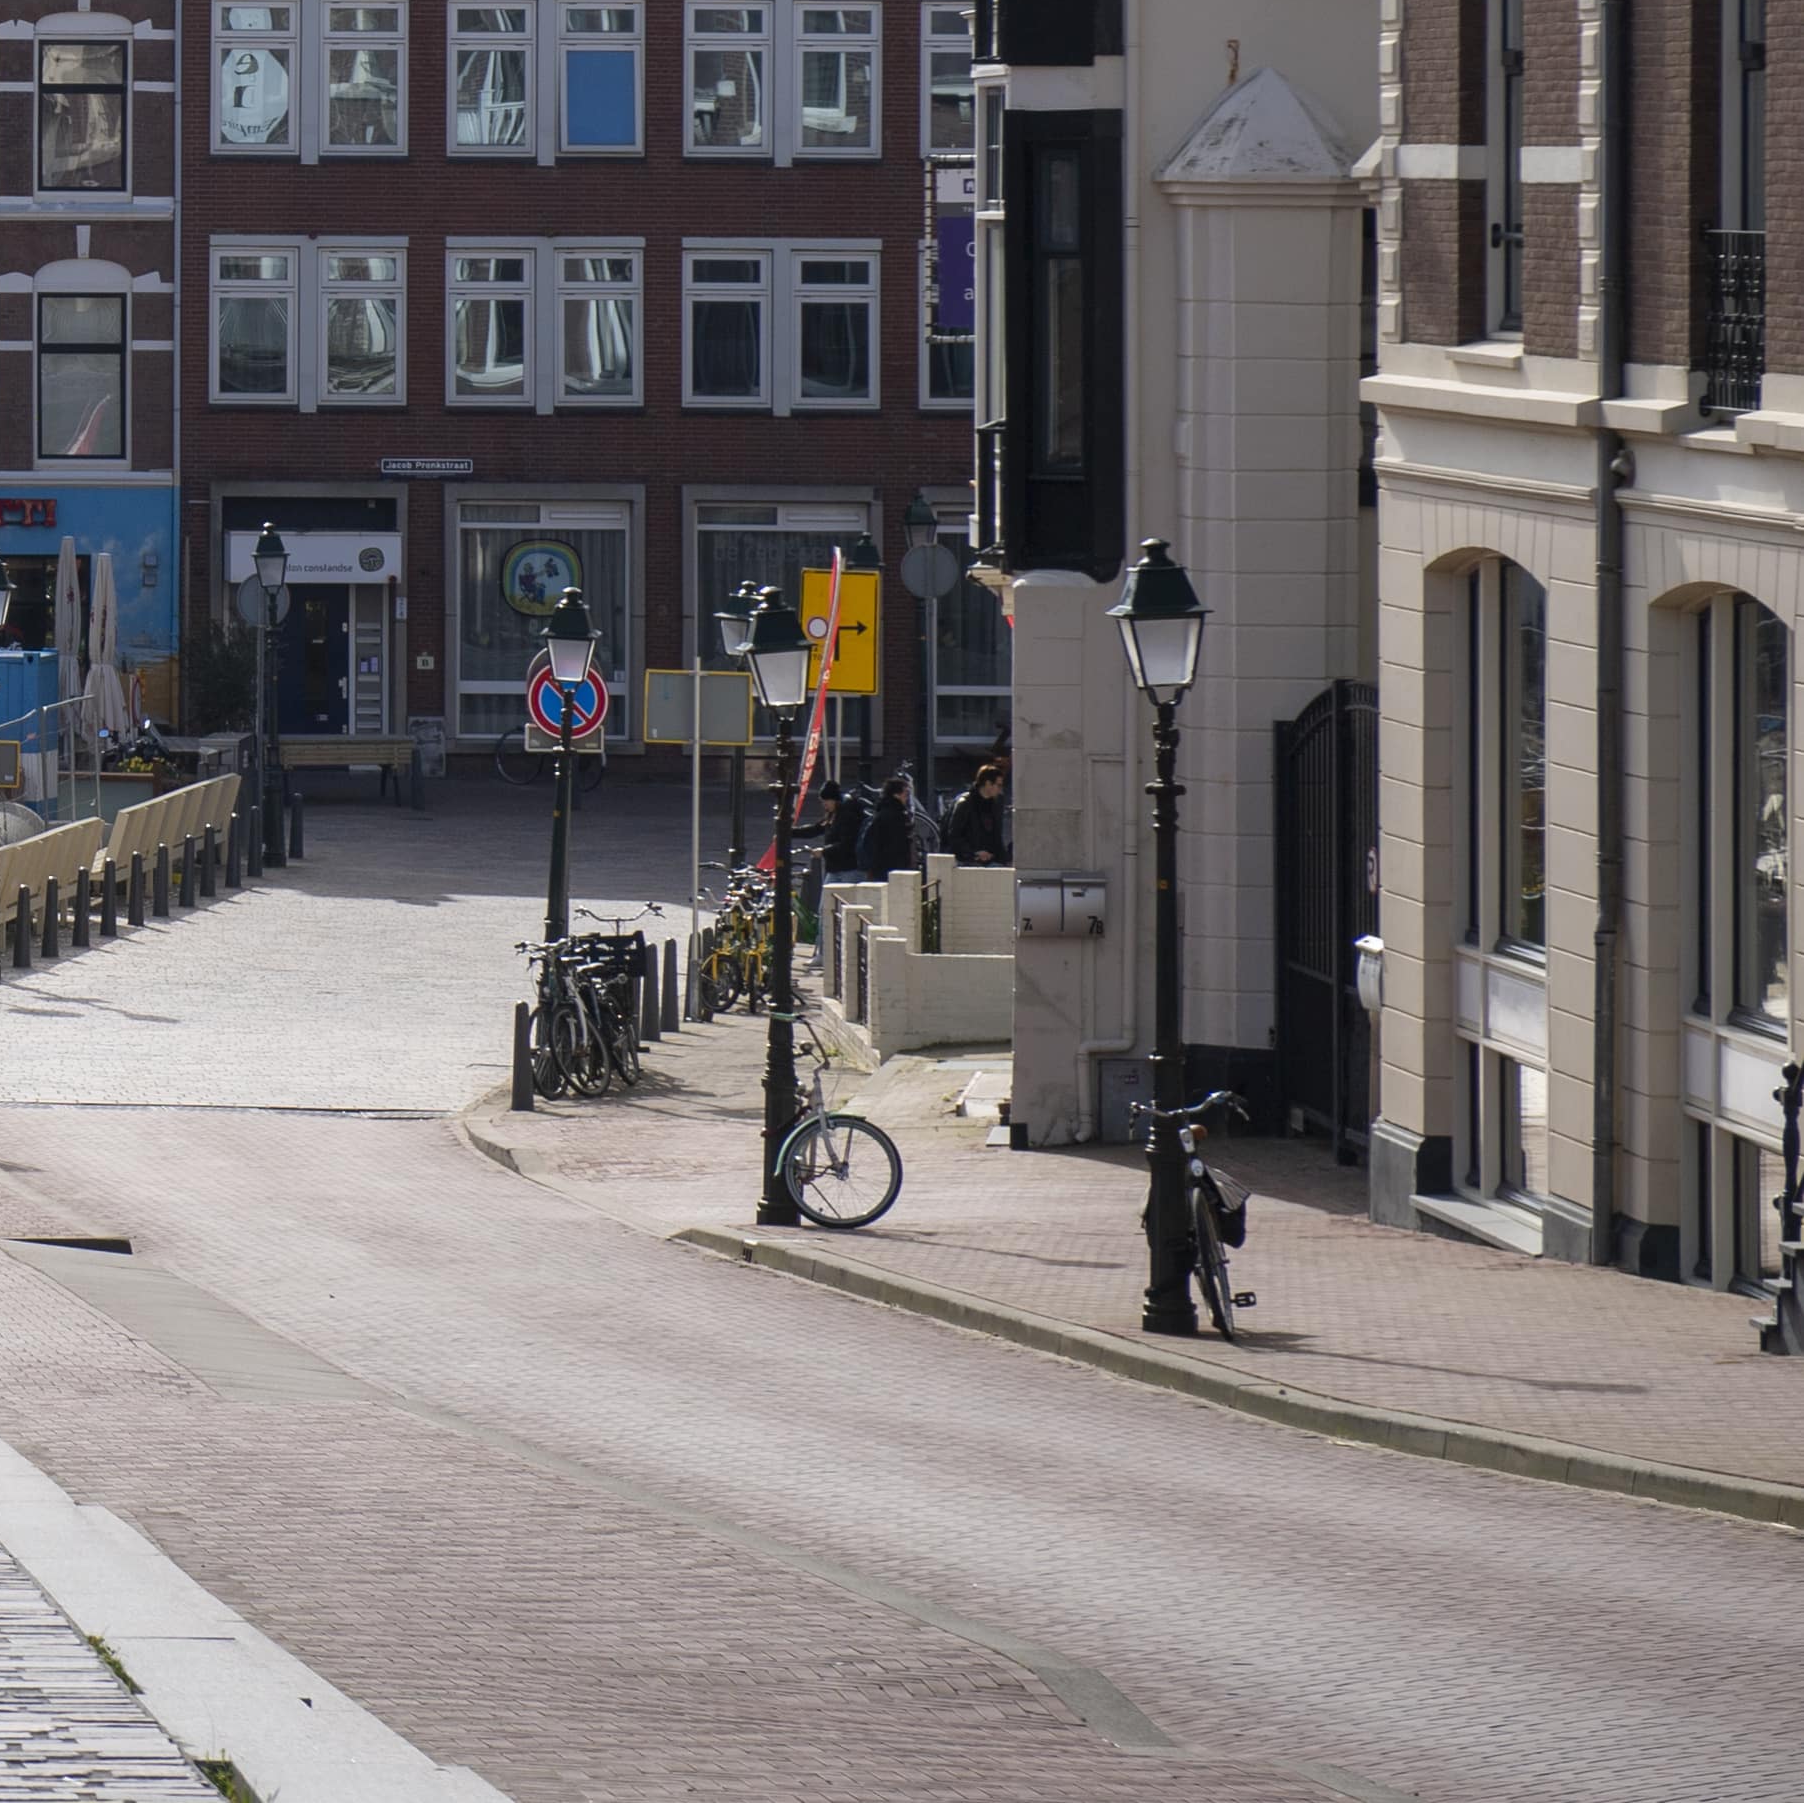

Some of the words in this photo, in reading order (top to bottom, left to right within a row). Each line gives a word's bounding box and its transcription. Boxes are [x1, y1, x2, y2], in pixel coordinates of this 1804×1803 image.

[385, 461, 412, 470] Jacob
[415, 461, 468, 470] Pronkstraat
[1087, 915, 1104, 935] 7B
